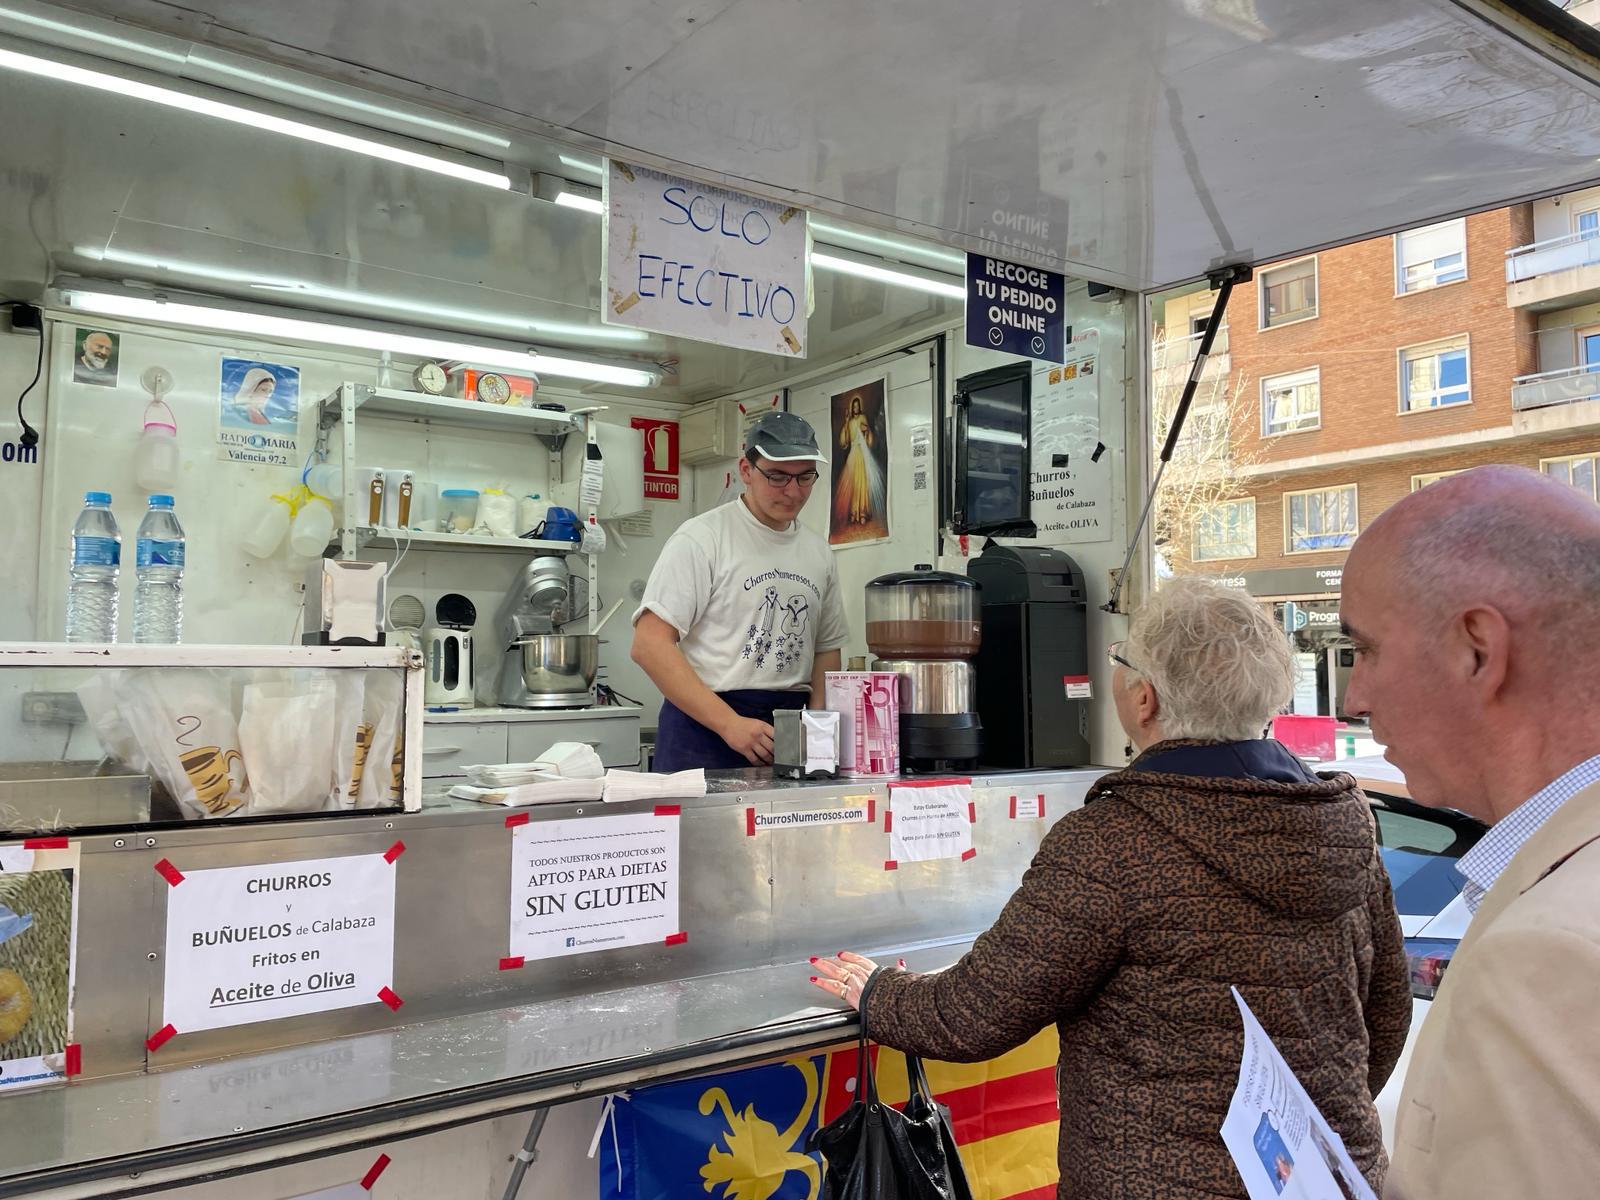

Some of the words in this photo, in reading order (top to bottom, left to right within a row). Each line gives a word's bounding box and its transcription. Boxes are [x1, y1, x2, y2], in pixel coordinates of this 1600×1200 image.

[659, 188, 771, 245] SOLO
[986, 259, 1048, 290] RECOGE
[638, 254, 795, 325] EFECTIVO
[976, 279, 996, 299] TU
[1001, 286, 1056, 314] PEDIDO
[988, 306, 1045, 333] ONLINE
[221, 433, 255, 444] RADIO
[261, 437, 296, 449] MARIA
[229, 450, 266, 462] Valencia
[269, 456, 287, 464] 97.2
[1030, 487, 1075, 501] Buñuelos
[1066, 501, 1096, 510] Calabaza
[1043, 522, 1065, 531] Aceite
[1070, 518, 1099, 529] OLIVA
[755, 809, 862, 825] ChurrosNumerosos.com
[529, 857, 558, 867] TODOS
[560, 853, 601, 864] NUESTROS
[602, 848, 649, 860] PRODUCTOS
[650, 846, 666, 855] SON
[247, 872, 332, 895] CHURROS
[528, 870, 575, 887] APTOS
[579, 866, 616, 882] PARA
[621, 860, 667, 877] DIETAS
[285, 903, 292, 912] y
[526, 893, 567, 918] SIN
[575, 881, 668, 911] GLUTEN
[192, 921, 292, 947] BUÑUELOS
[296, 925, 309, 936] de
[311, 914, 376, 934] Calabaza
[252, 951, 297, 968] Fritos
[301, 950, 320, 962] en
[210, 983, 274, 1005] Aceite
[281, 979, 302, 995] de
[307, 970, 356, 991] Oliva
